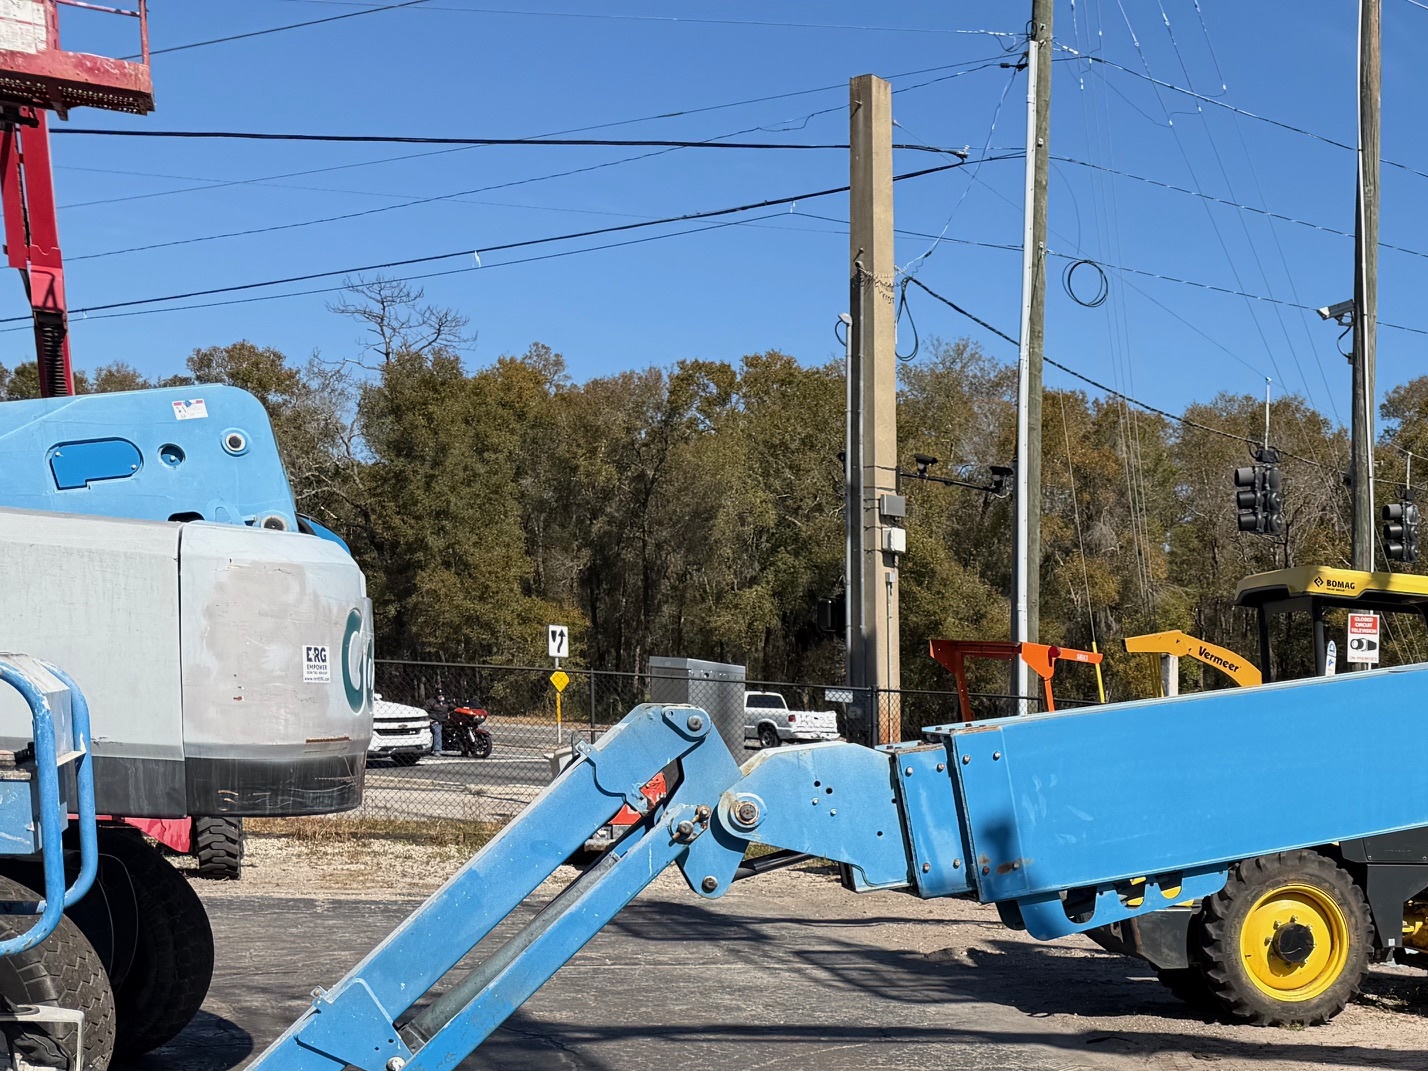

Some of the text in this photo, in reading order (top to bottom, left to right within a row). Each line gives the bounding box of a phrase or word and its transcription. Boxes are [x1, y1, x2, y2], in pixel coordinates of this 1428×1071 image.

[1326, 579, 1356, 590] BOMAG
[306, 646, 327, 663] ERG
[1198, 646, 1240, 673] Vermeer
